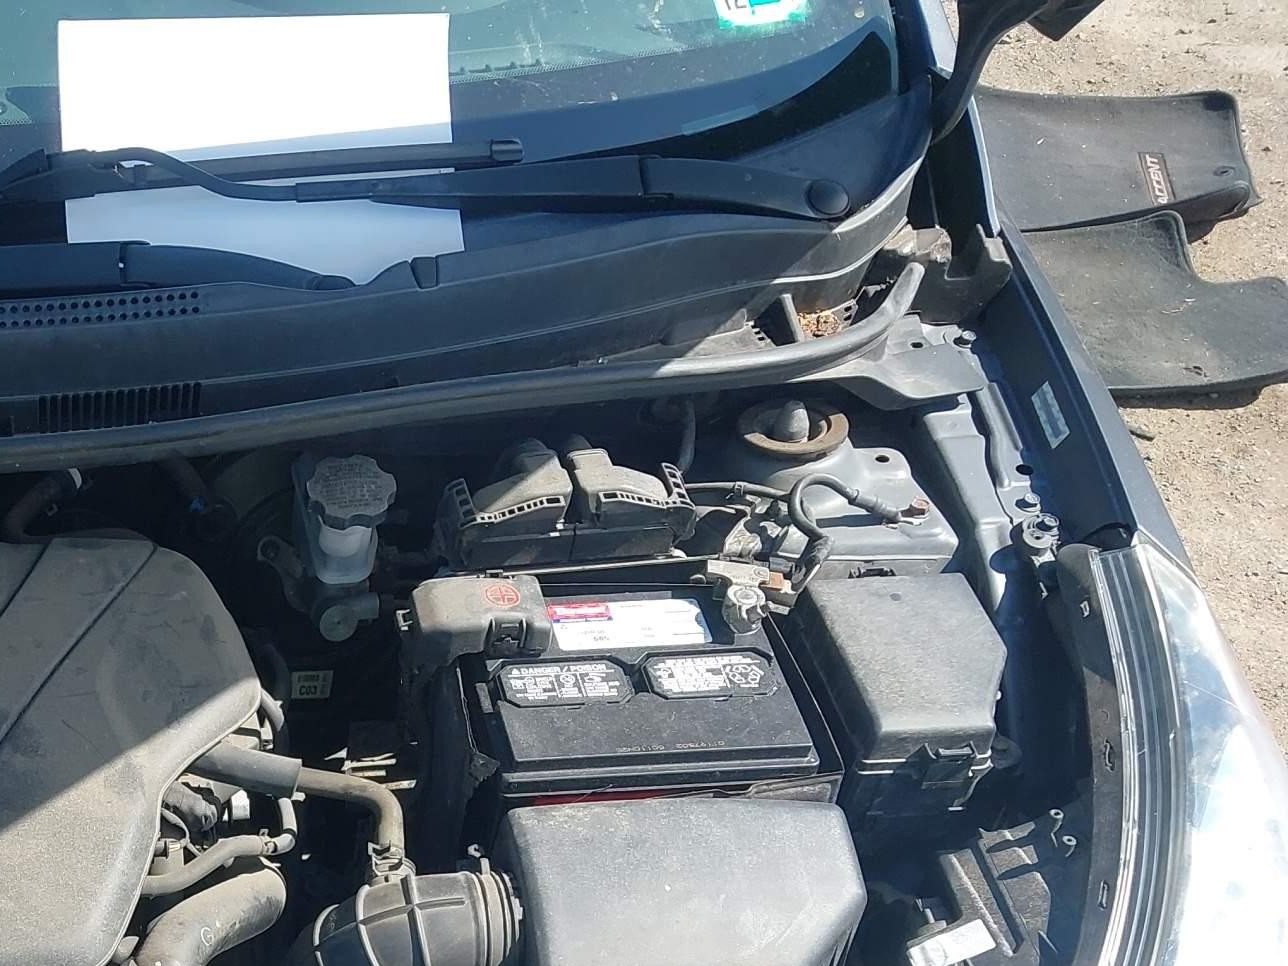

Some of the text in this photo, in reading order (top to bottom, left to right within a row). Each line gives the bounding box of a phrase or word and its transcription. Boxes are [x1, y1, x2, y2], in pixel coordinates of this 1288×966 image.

[1145, 154, 1168, 204] ACCENT
[520, 667, 561, 675] DANGER
[571, 664, 606, 672] POISON
